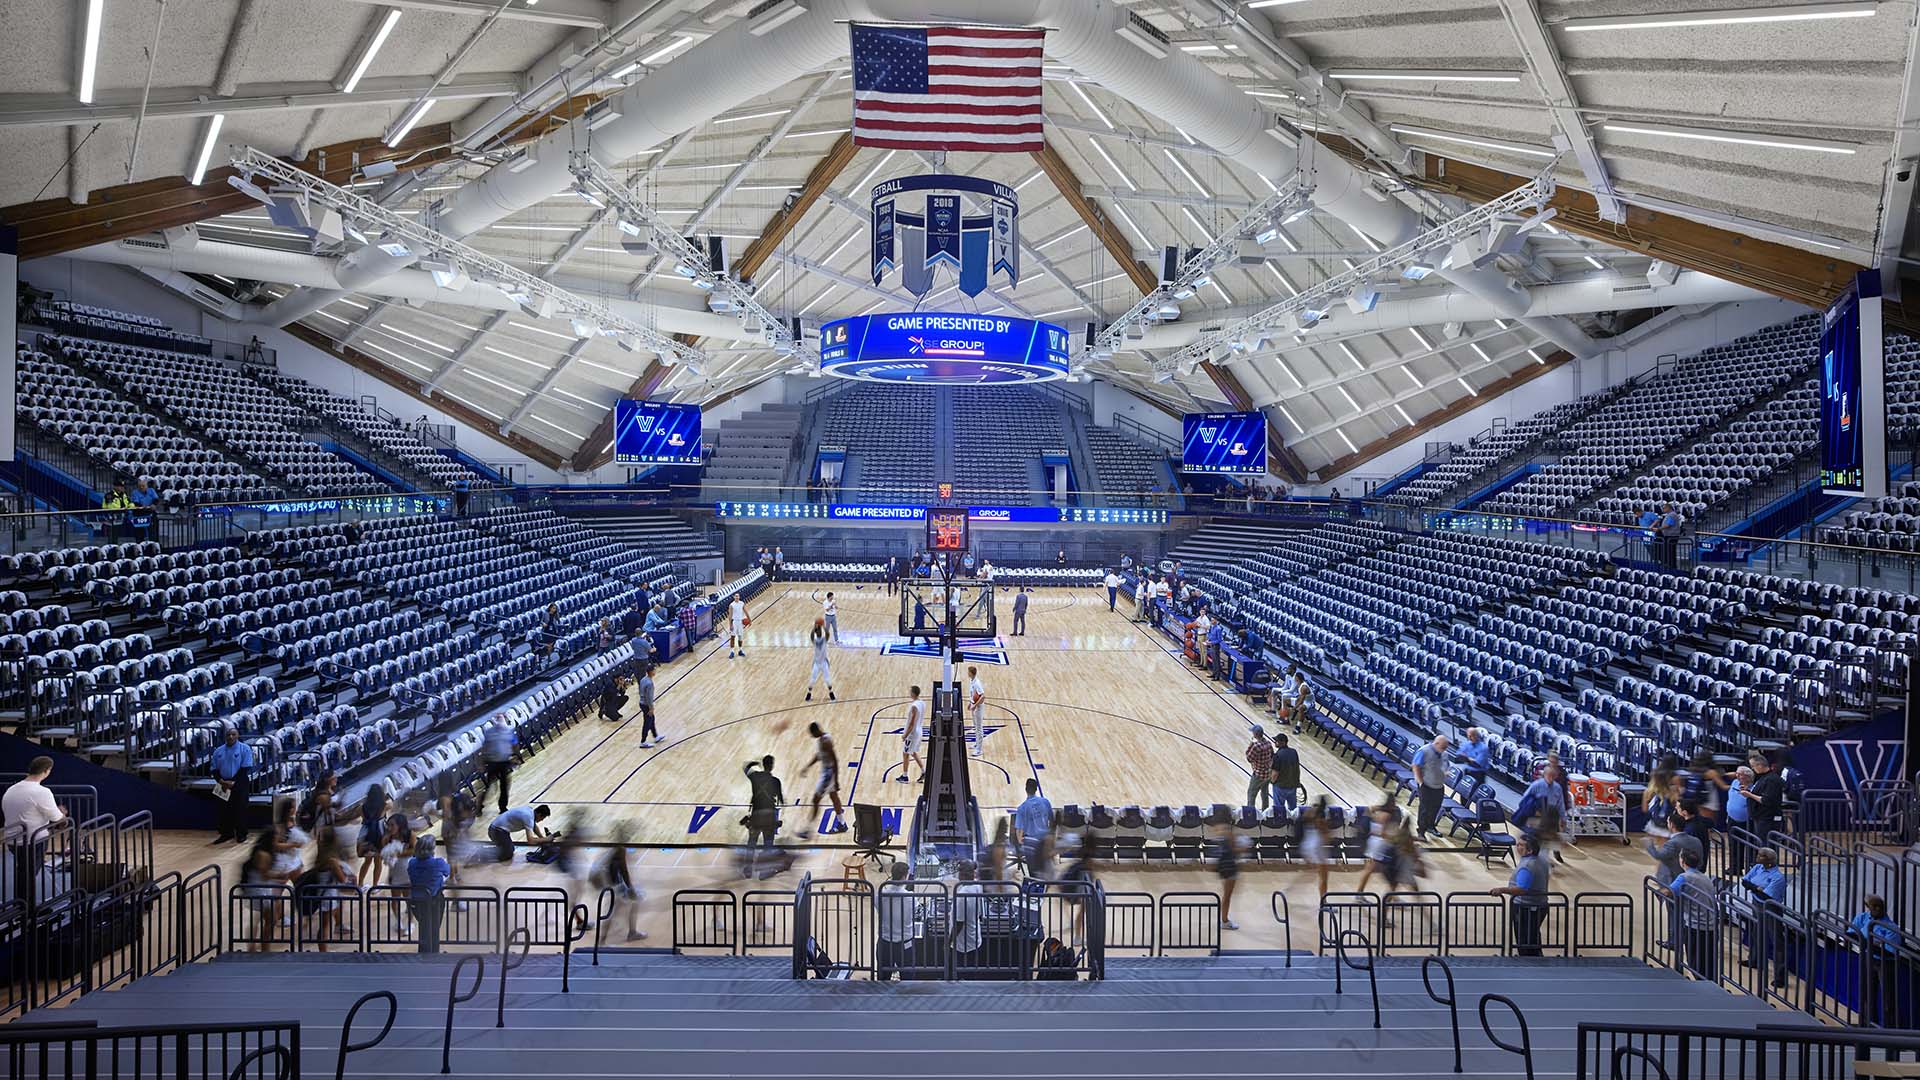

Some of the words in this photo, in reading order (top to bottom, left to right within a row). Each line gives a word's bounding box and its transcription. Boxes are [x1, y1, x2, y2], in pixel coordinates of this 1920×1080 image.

[933, 198, 953, 207] 2018
[887, 317, 923, 330] GAME
[925, 317, 994, 332] PRESENTED
[996, 320, 1011, 333] BY
[940, 339, 982, 350] GROUP
[655, 427, 666, 436] VS
[1217, 438, 1228, 446] VS
[940, 489, 951, 497] 30
[835, 507, 861, 517] GAME
[863, 507, 910, 518] PRESENTED
[912, 508, 925, 518] BY
[979, 509, 1009, 517] GROUP
[936, 527, 960, 548] 30
[1825, 740, 1905, 824] V
